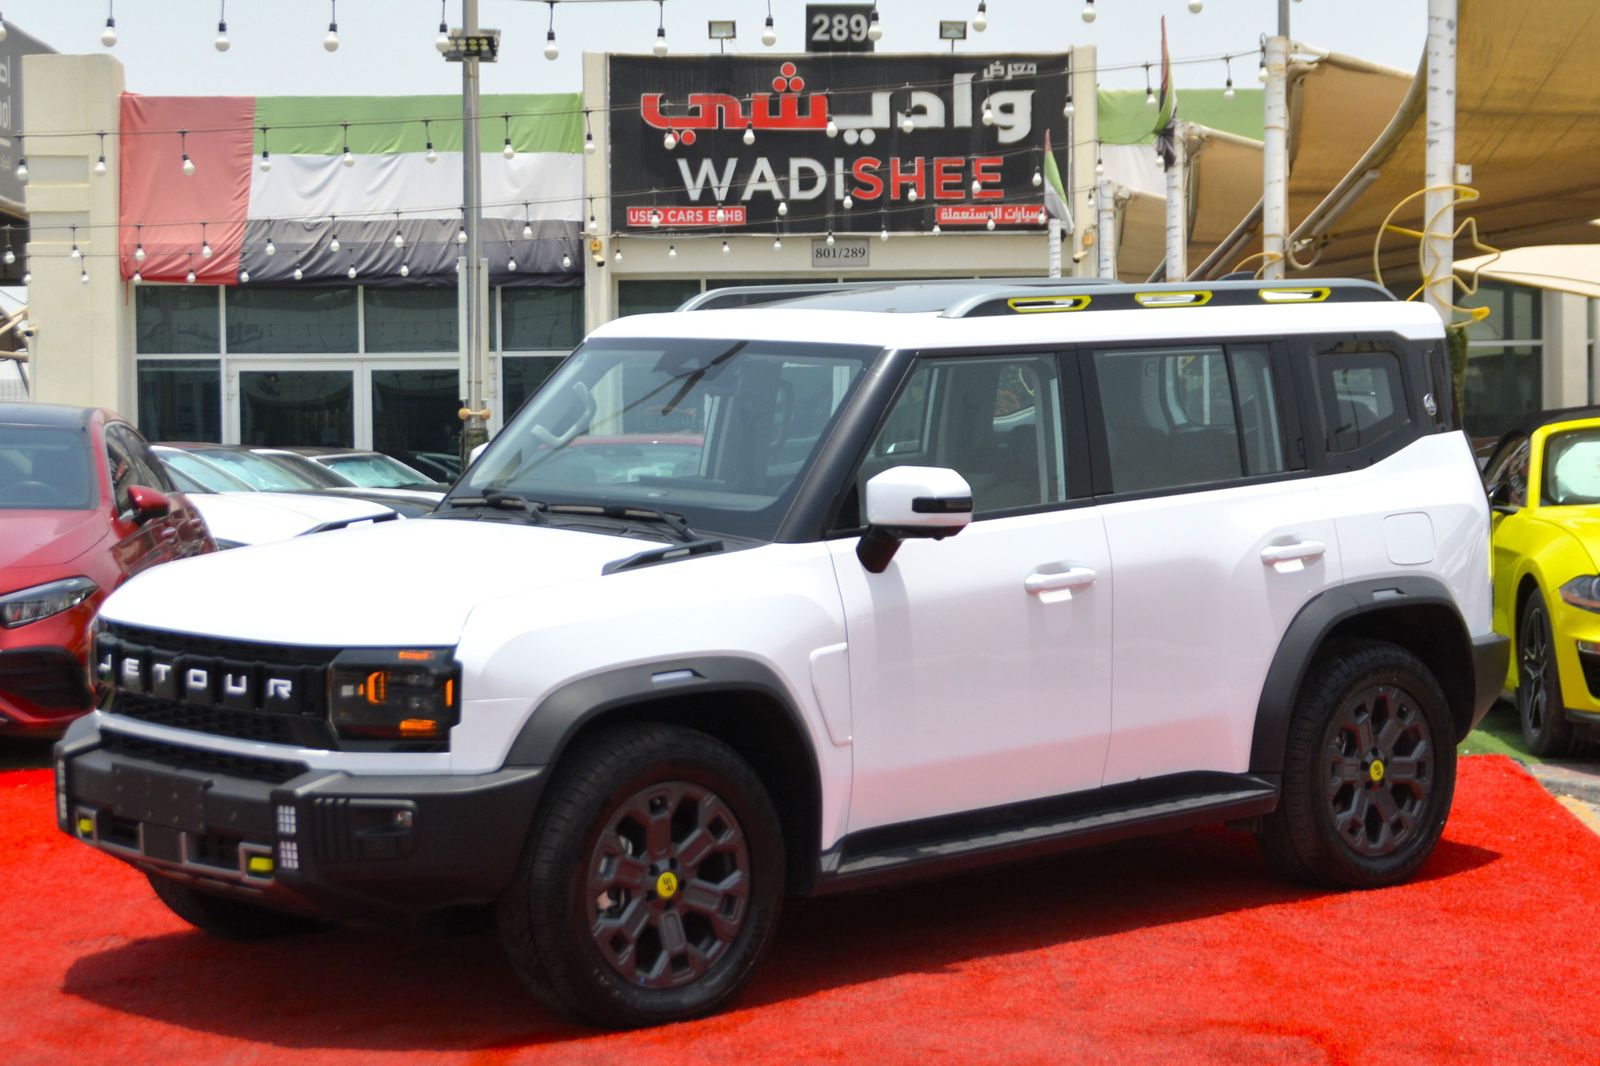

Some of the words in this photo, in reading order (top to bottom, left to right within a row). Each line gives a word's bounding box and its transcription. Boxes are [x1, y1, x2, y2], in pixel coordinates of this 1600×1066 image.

[812, 13, 868, 42] 289
[983, 60, 1037, 79] معرض
[677, 156, 1004, 201] WADISHEE
[667, 210, 703, 222] CARS
[708, 210, 743, 222] EHB
[941, 207, 1002, 220] المستعملة
[815, 247, 866, 259] 801/289
[99, 653, 292, 699] JETOUR
